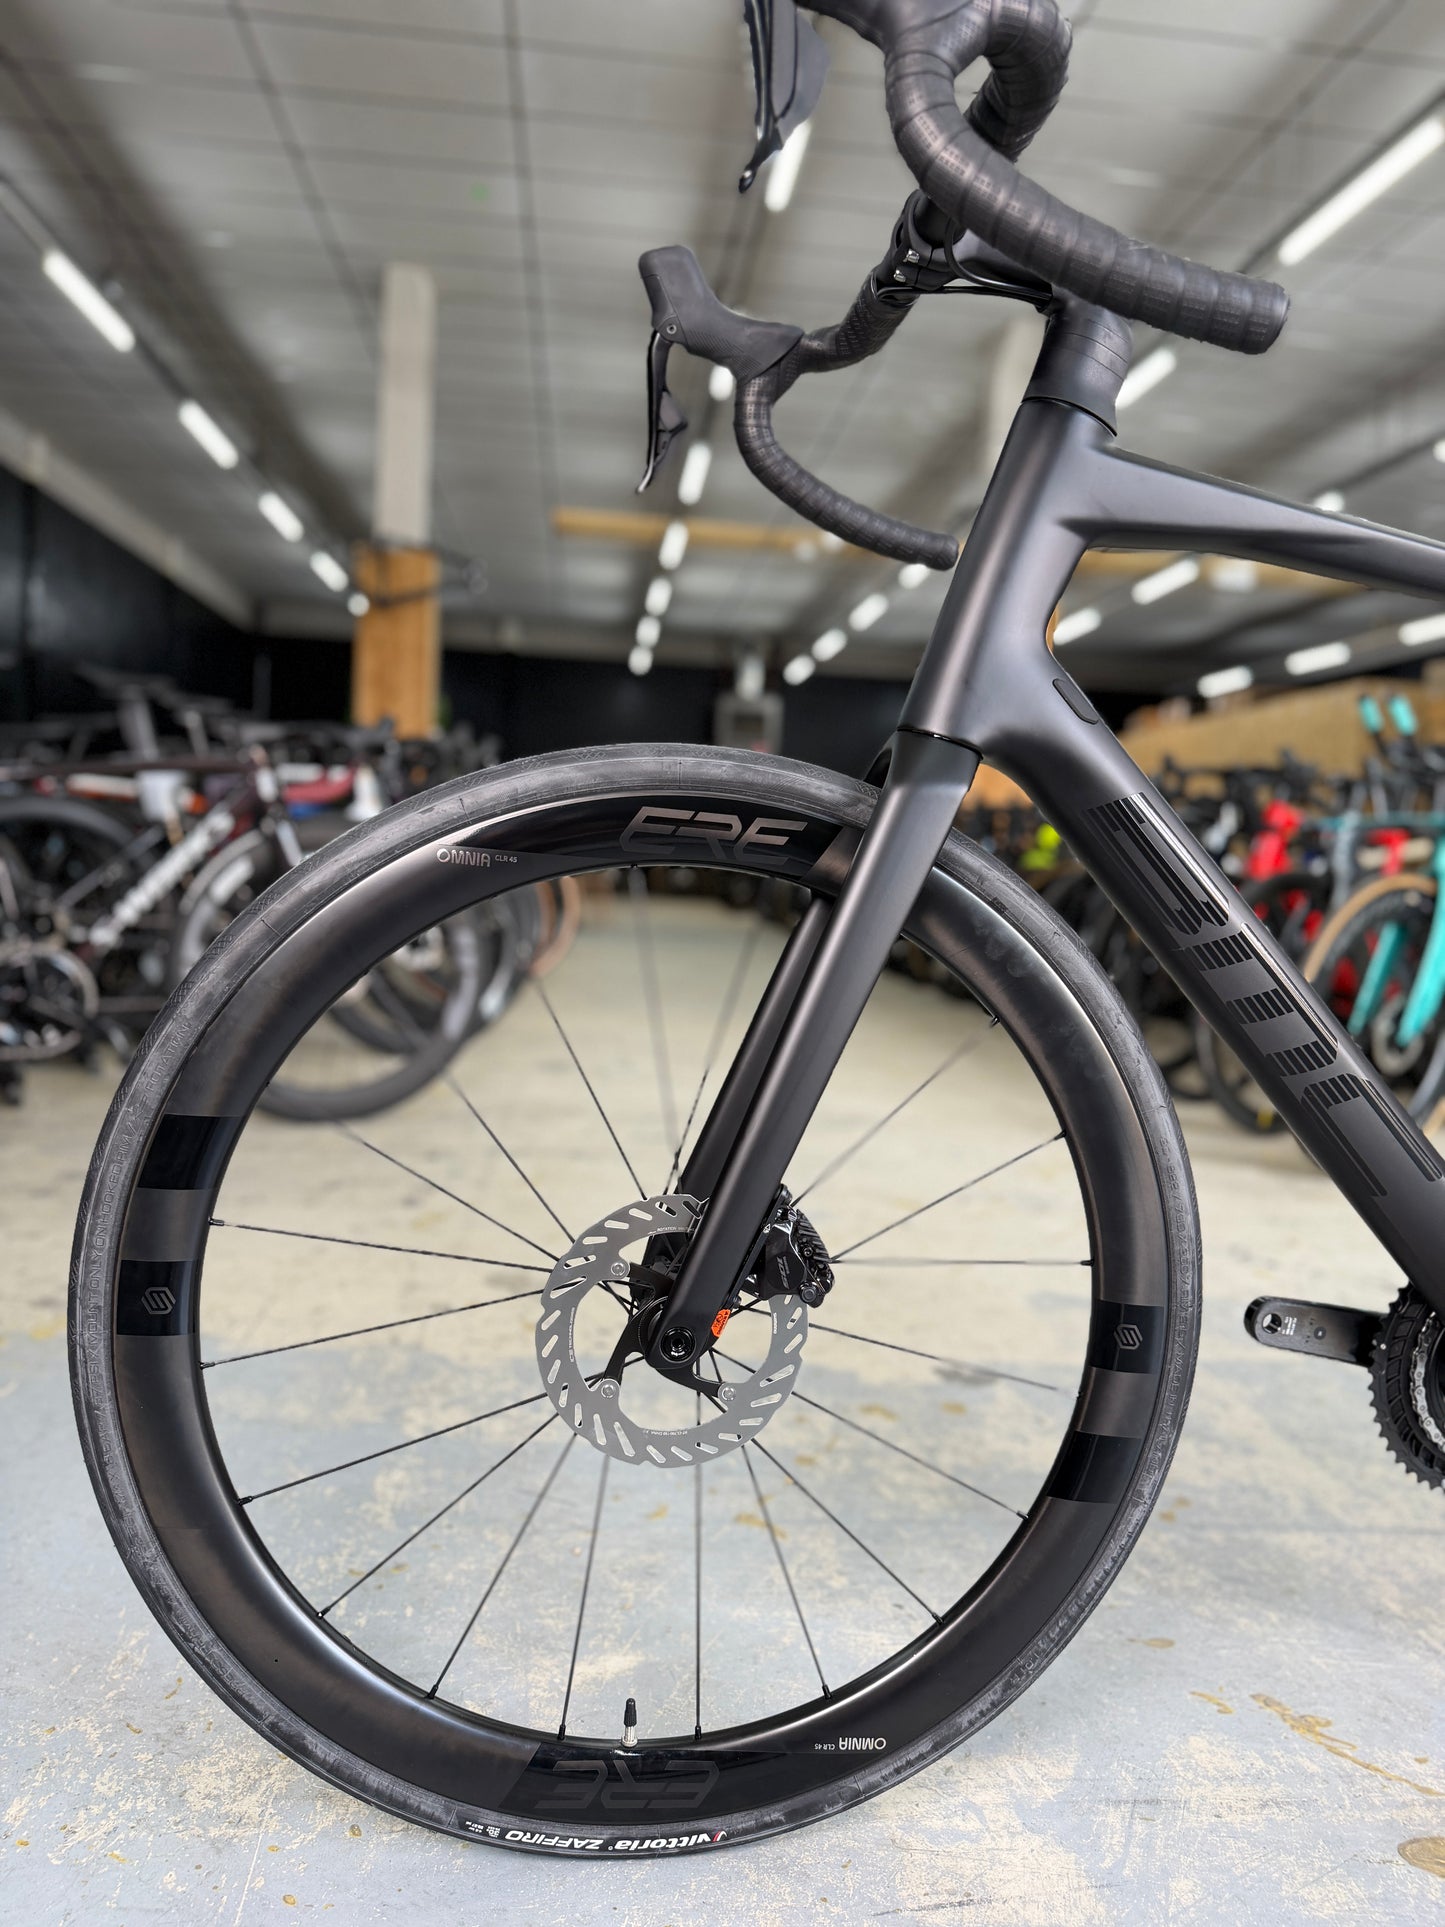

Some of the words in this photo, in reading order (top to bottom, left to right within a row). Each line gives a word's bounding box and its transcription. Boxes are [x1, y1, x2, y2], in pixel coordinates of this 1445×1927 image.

[619, 806, 808, 866] ERE
[437, 848, 490, 867] OMNIA
[495, 854, 508, 862] CLR
[97, 1161, 124, 1224] HOOKED
[88, 1248, 103, 1289] ONLY
[86, 1292, 99, 1346] MOUNT
[814, 1743, 823, 1751] 45
[823, 1743, 835, 1751] CLR
[838, 1737, 887, 1751] OMNIA
[533, 1760, 720, 1809] ERE
[504, 1829, 605, 1851] ZAFFIRO
